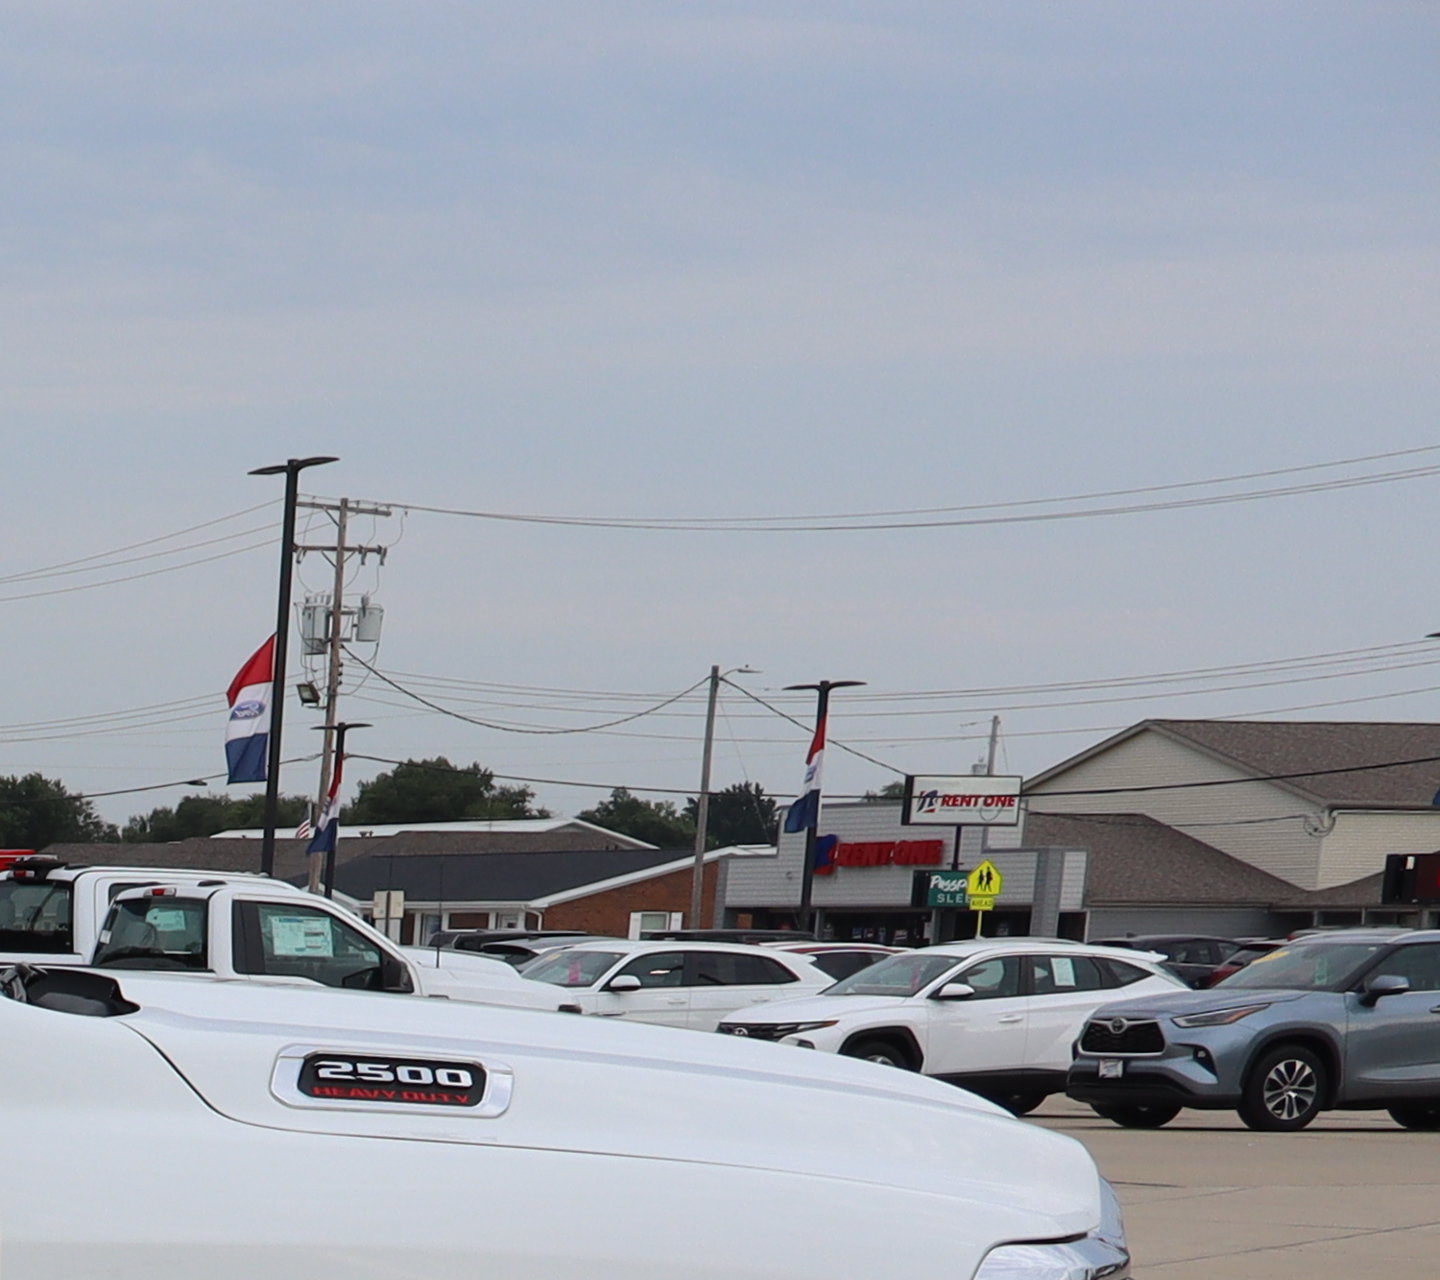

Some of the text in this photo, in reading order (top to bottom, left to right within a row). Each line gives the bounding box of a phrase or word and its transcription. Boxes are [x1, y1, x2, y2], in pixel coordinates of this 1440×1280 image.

[940, 794, 1016, 808] RENT ONE
[837, 839, 944, 867] RENT ONE
[313, 1060, 473, 1088] 2500
[311, 1086, 471, 1105] HEAVY DUTY
